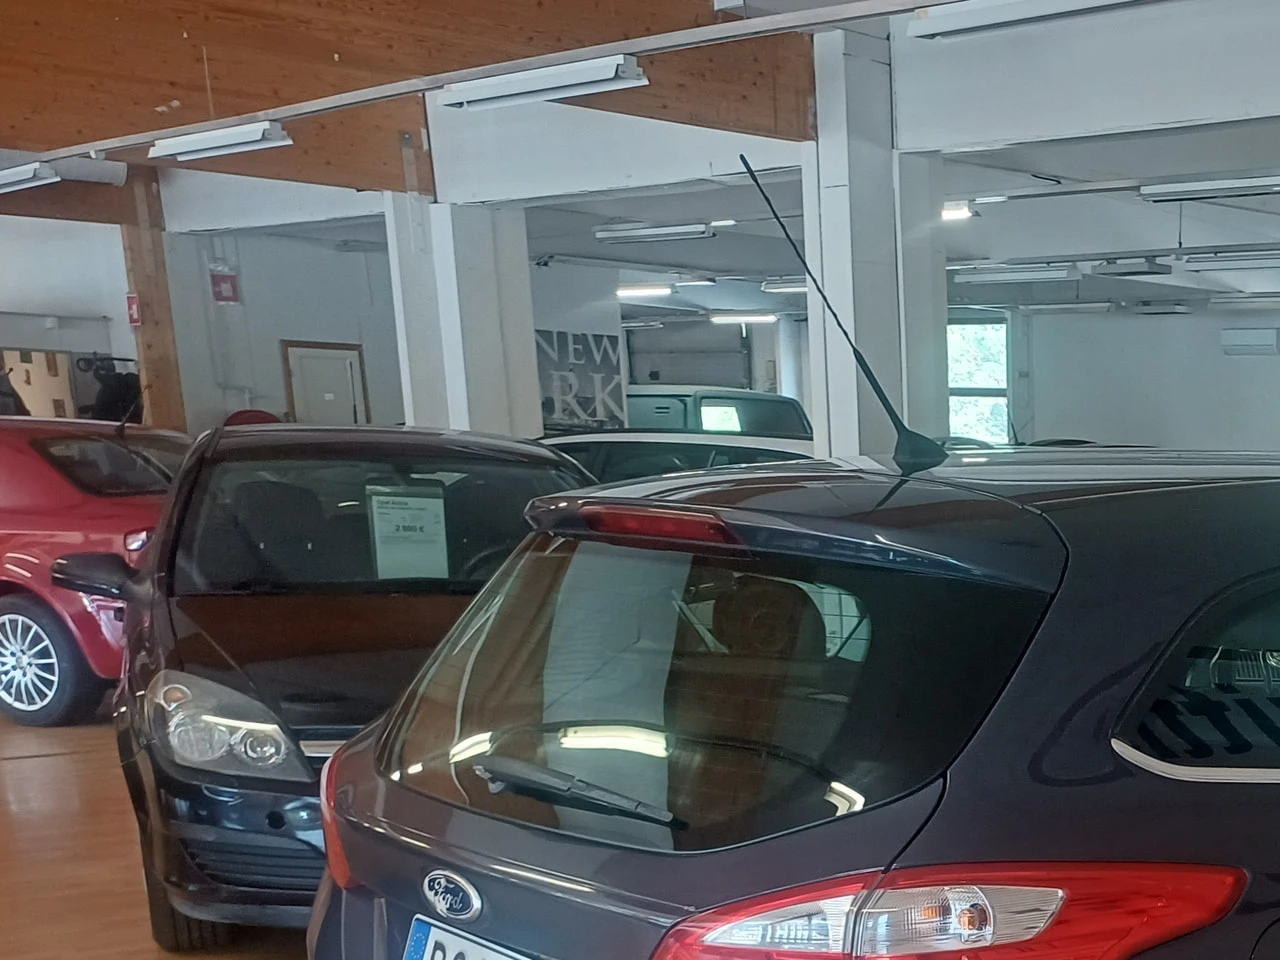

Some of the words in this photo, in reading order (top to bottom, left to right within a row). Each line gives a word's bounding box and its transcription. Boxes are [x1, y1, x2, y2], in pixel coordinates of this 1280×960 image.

[535, 330, 621, 366] NEW
[549, 370, 625, 422] RK
[488, 439, 516, 450] TEILLE
[430, 878, 464, 909] Ford
